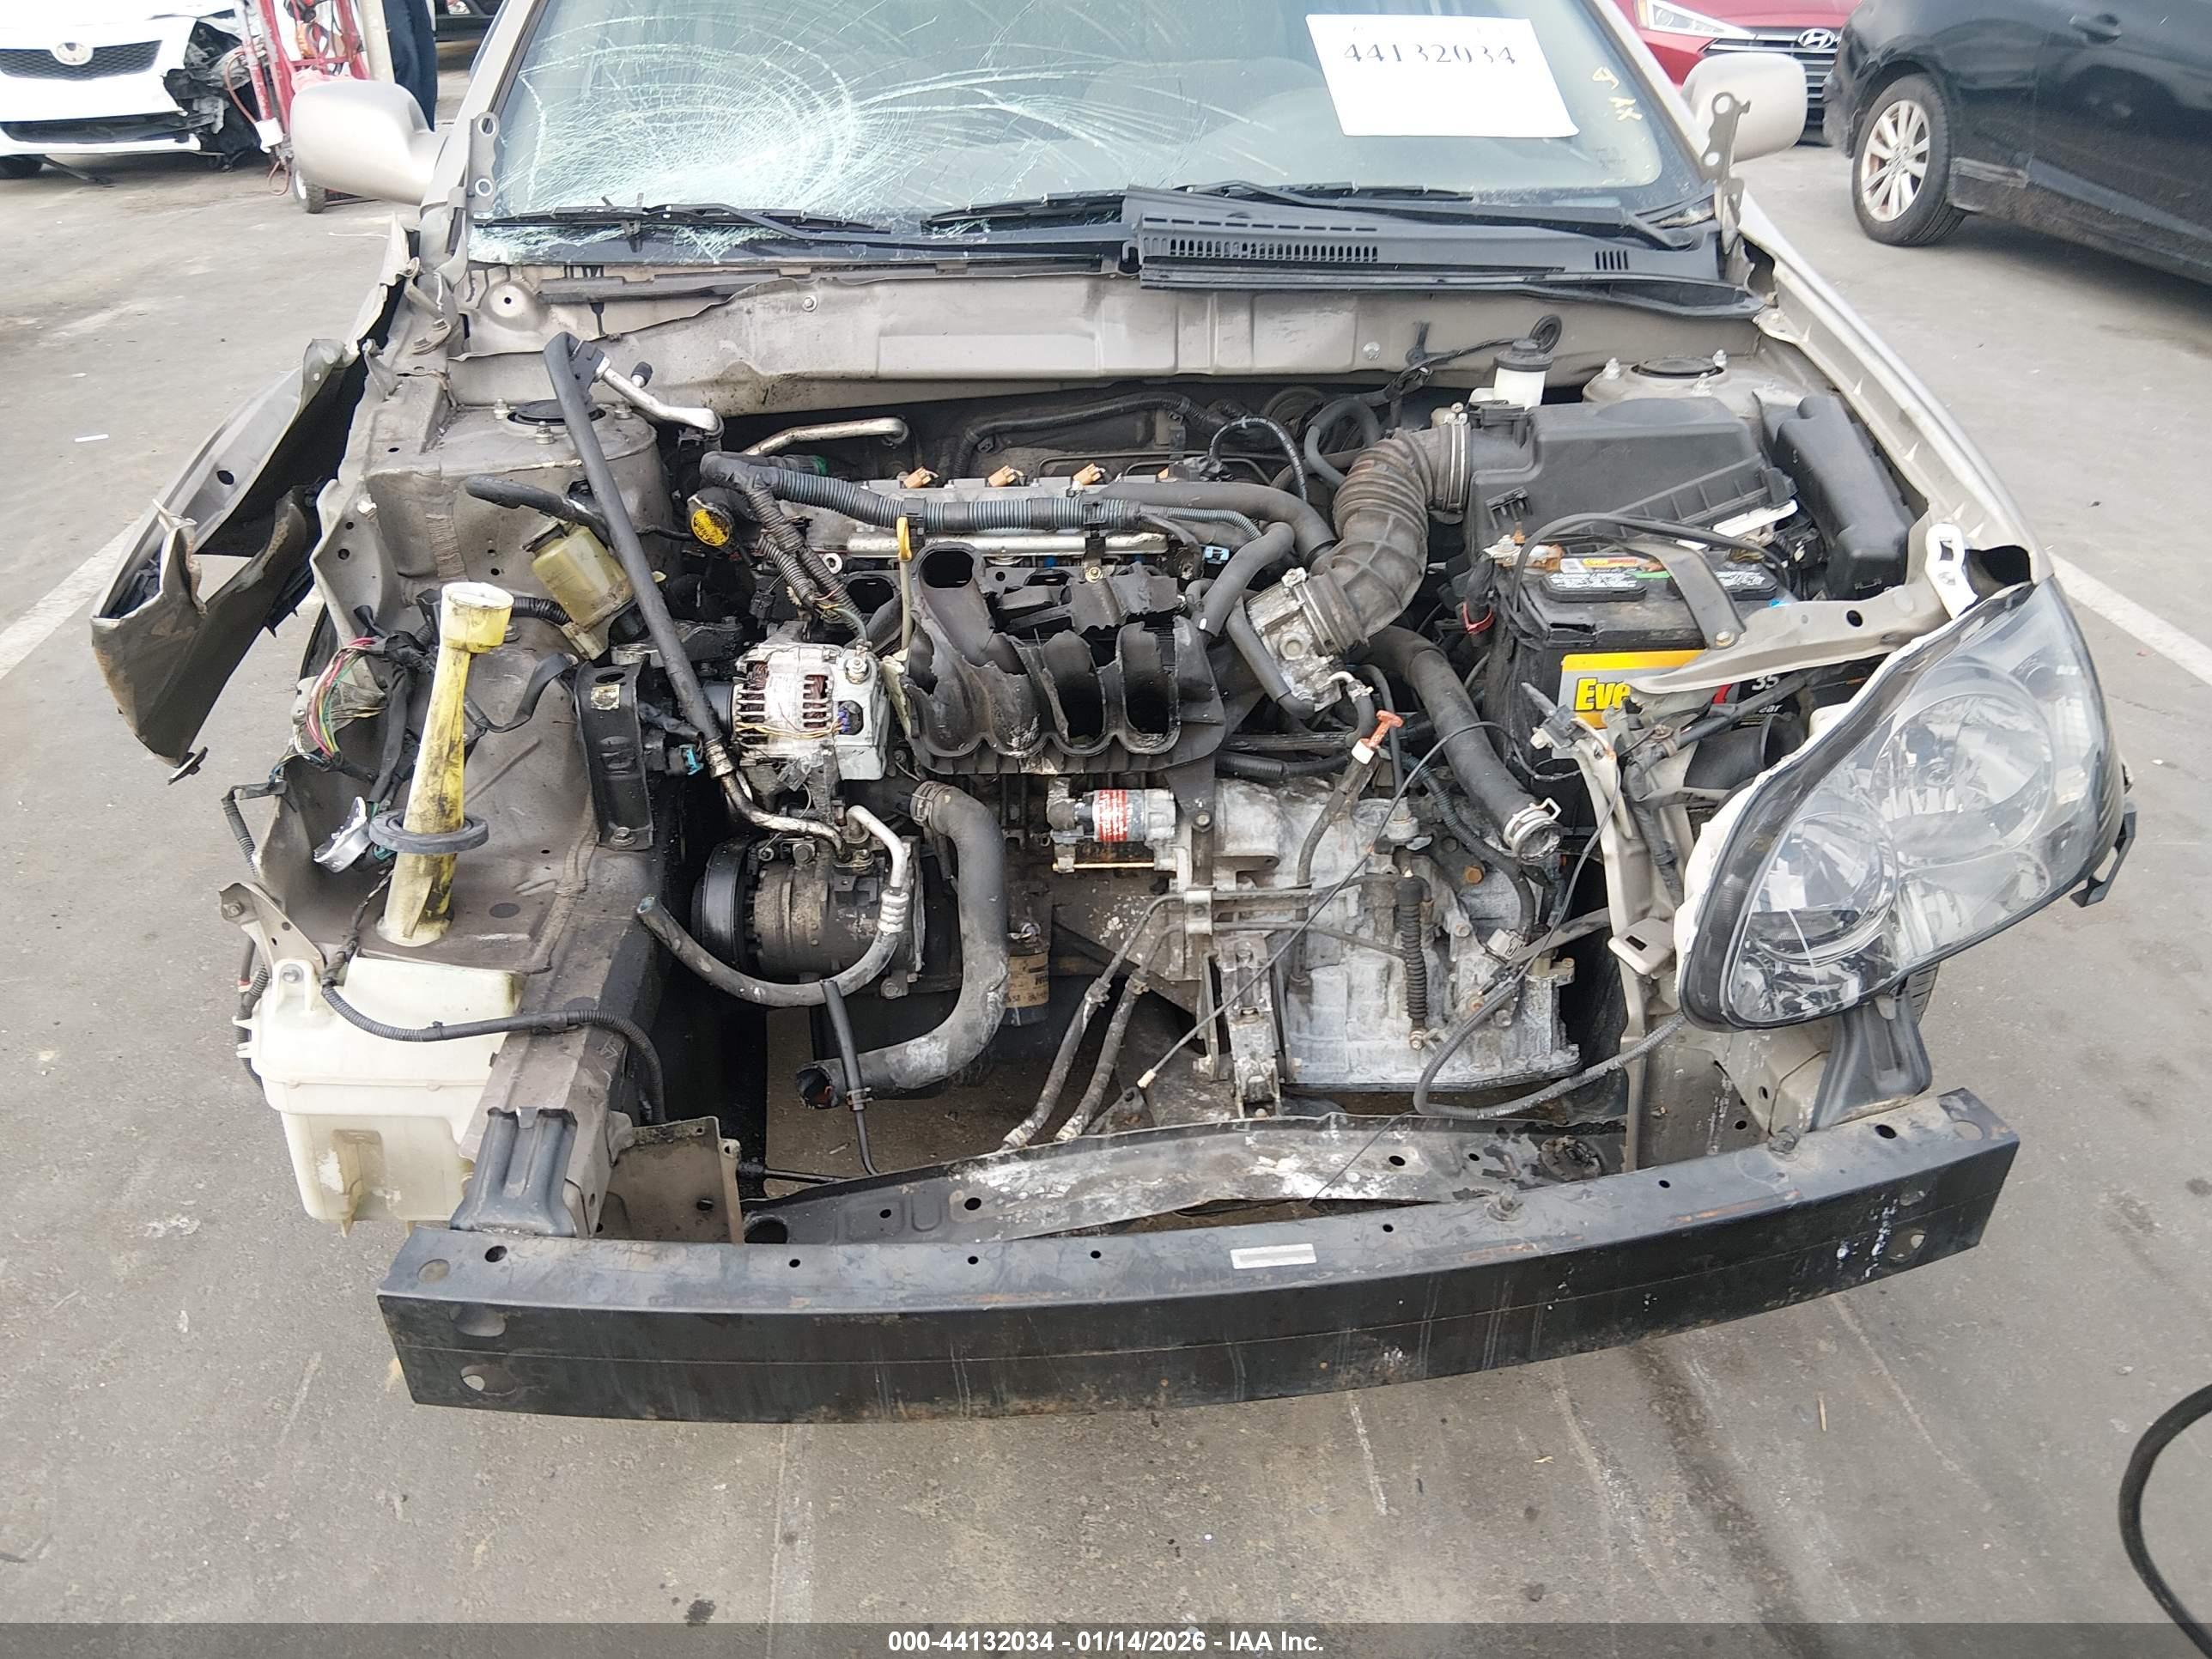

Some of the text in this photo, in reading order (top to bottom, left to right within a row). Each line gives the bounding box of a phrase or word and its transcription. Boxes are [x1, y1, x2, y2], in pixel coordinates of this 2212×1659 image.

[1344, 44, 1516, 64] 44132034
[1575, 677, 1632, 711] Eve
[1758, 704, 1784, 714] ear
